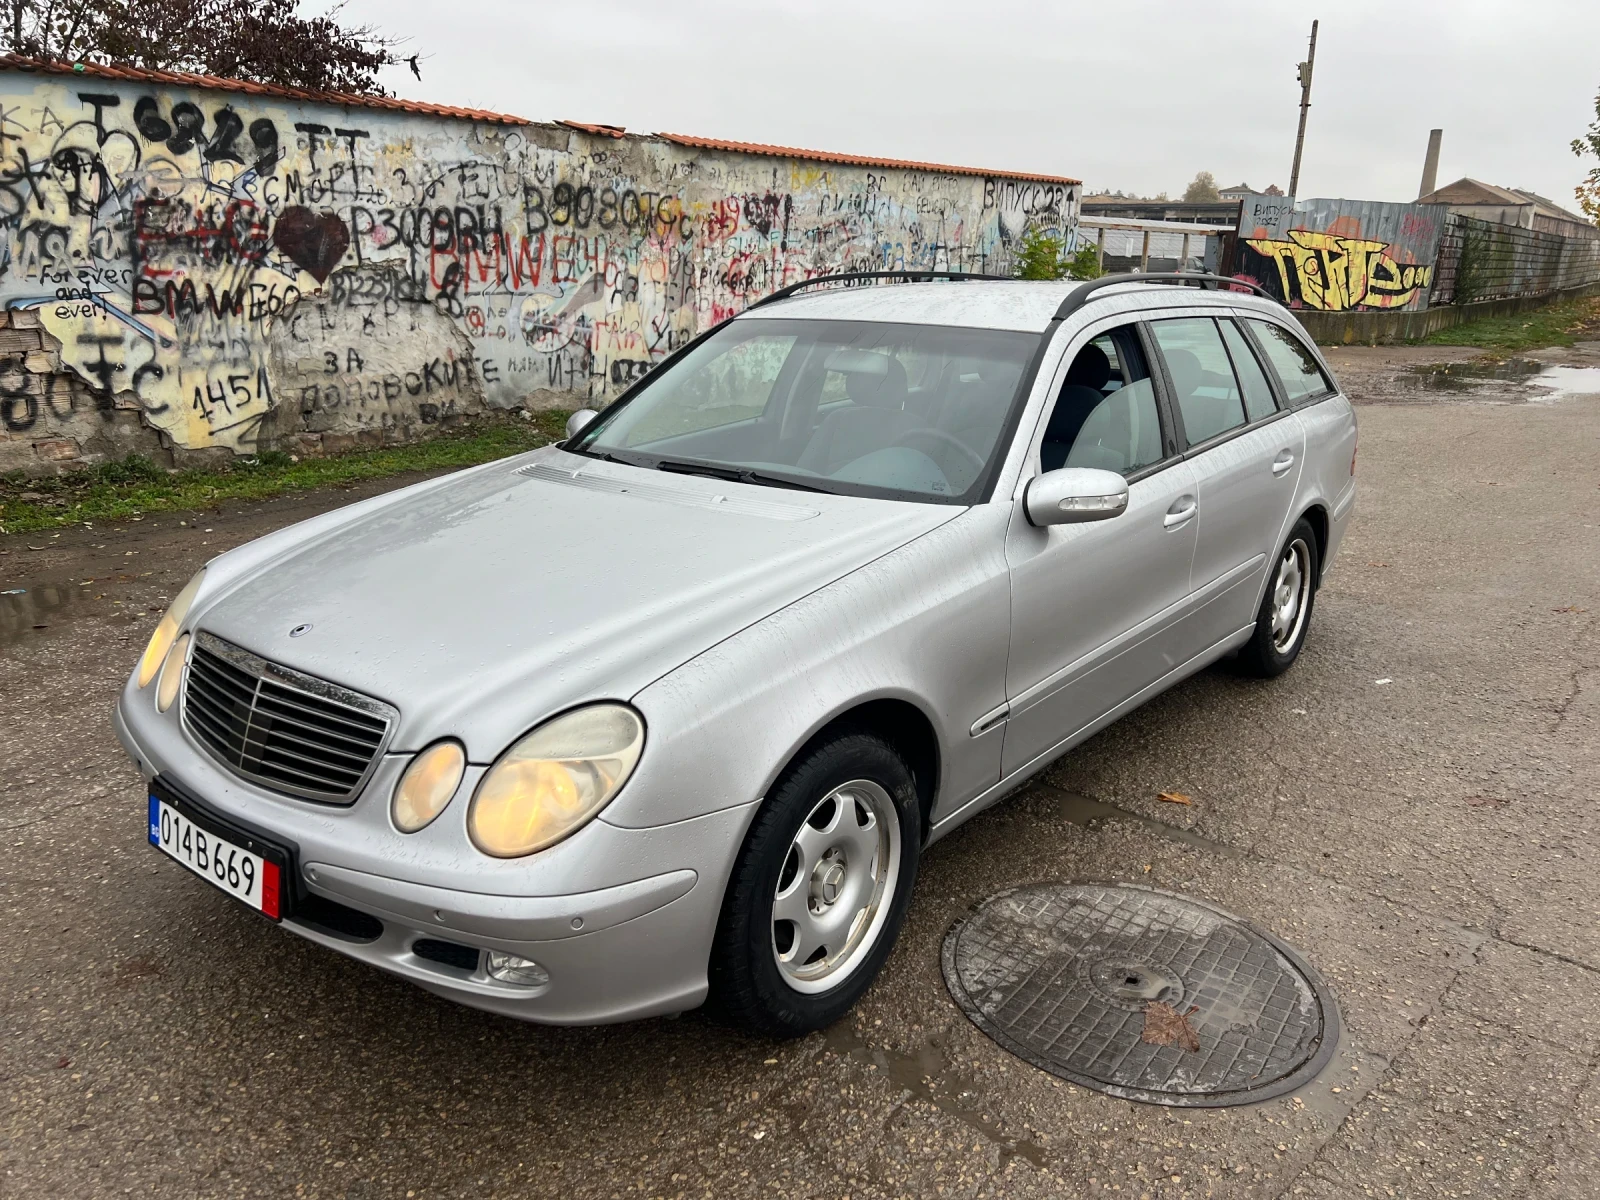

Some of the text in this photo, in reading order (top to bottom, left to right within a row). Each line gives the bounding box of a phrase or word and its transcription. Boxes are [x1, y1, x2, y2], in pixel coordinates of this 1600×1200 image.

[1253, 203, 1297, 217] ВИПУСК
[55, 281, 93, 301] and
[131, 278, 245, 321] BMW
[161, 808, 255, 896] 014B669
